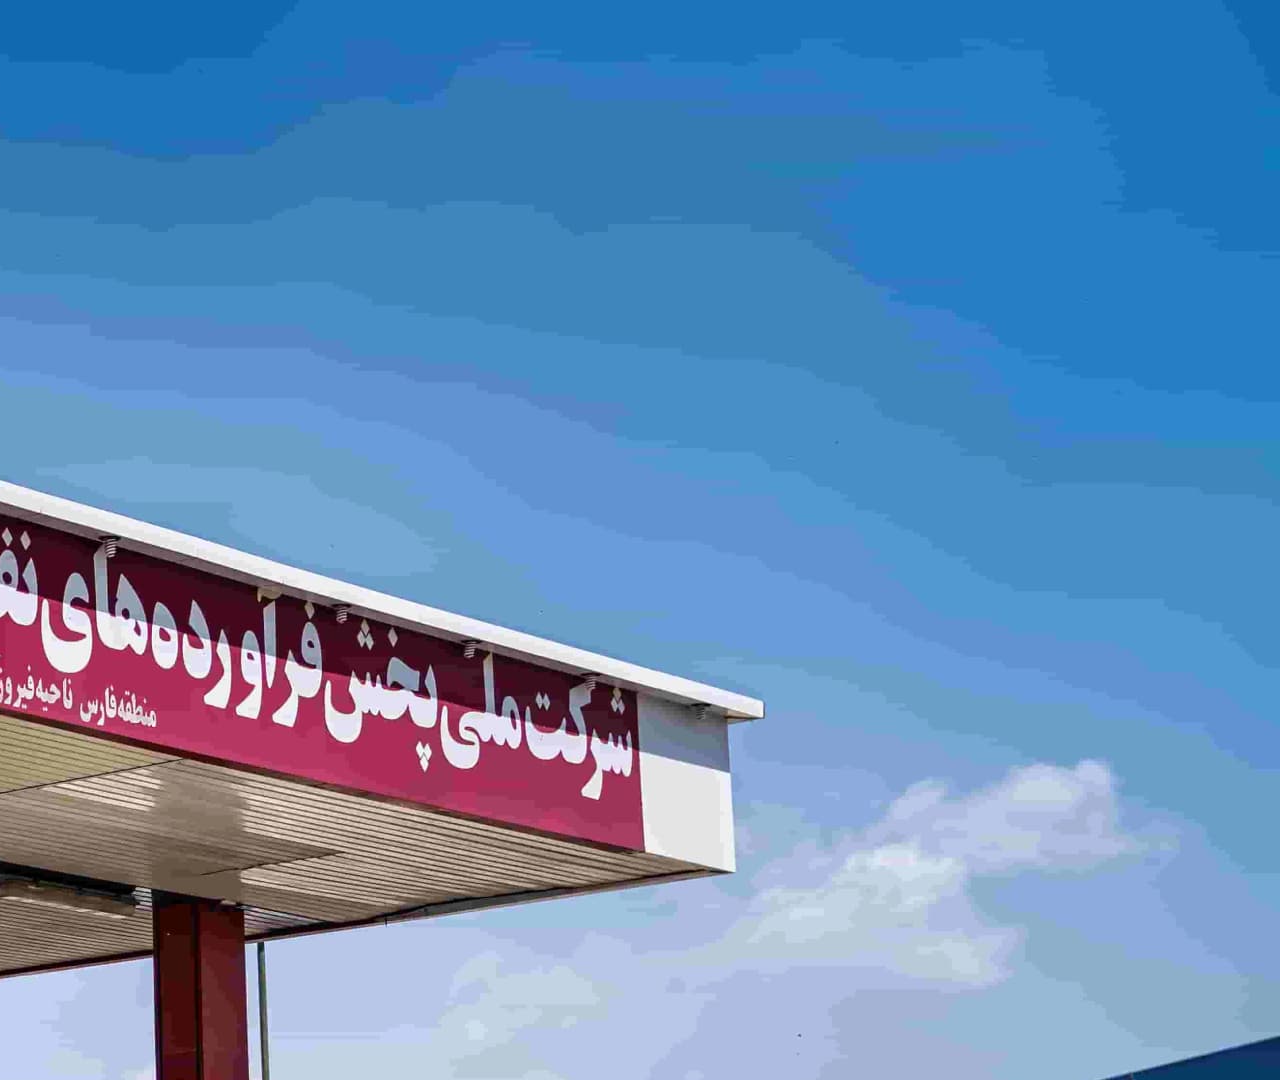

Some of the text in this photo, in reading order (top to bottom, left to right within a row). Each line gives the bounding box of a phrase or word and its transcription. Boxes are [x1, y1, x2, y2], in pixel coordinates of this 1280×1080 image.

[36, 678, 73, 712] ناحیه
[79, 685, 117, 726] فارس
[118, 691, 157, 728] منطقه
[324, 619, 439, 772] پخش
[440, 651, 522, 770] ملی
[524, 682, 633, 800] شرکت
